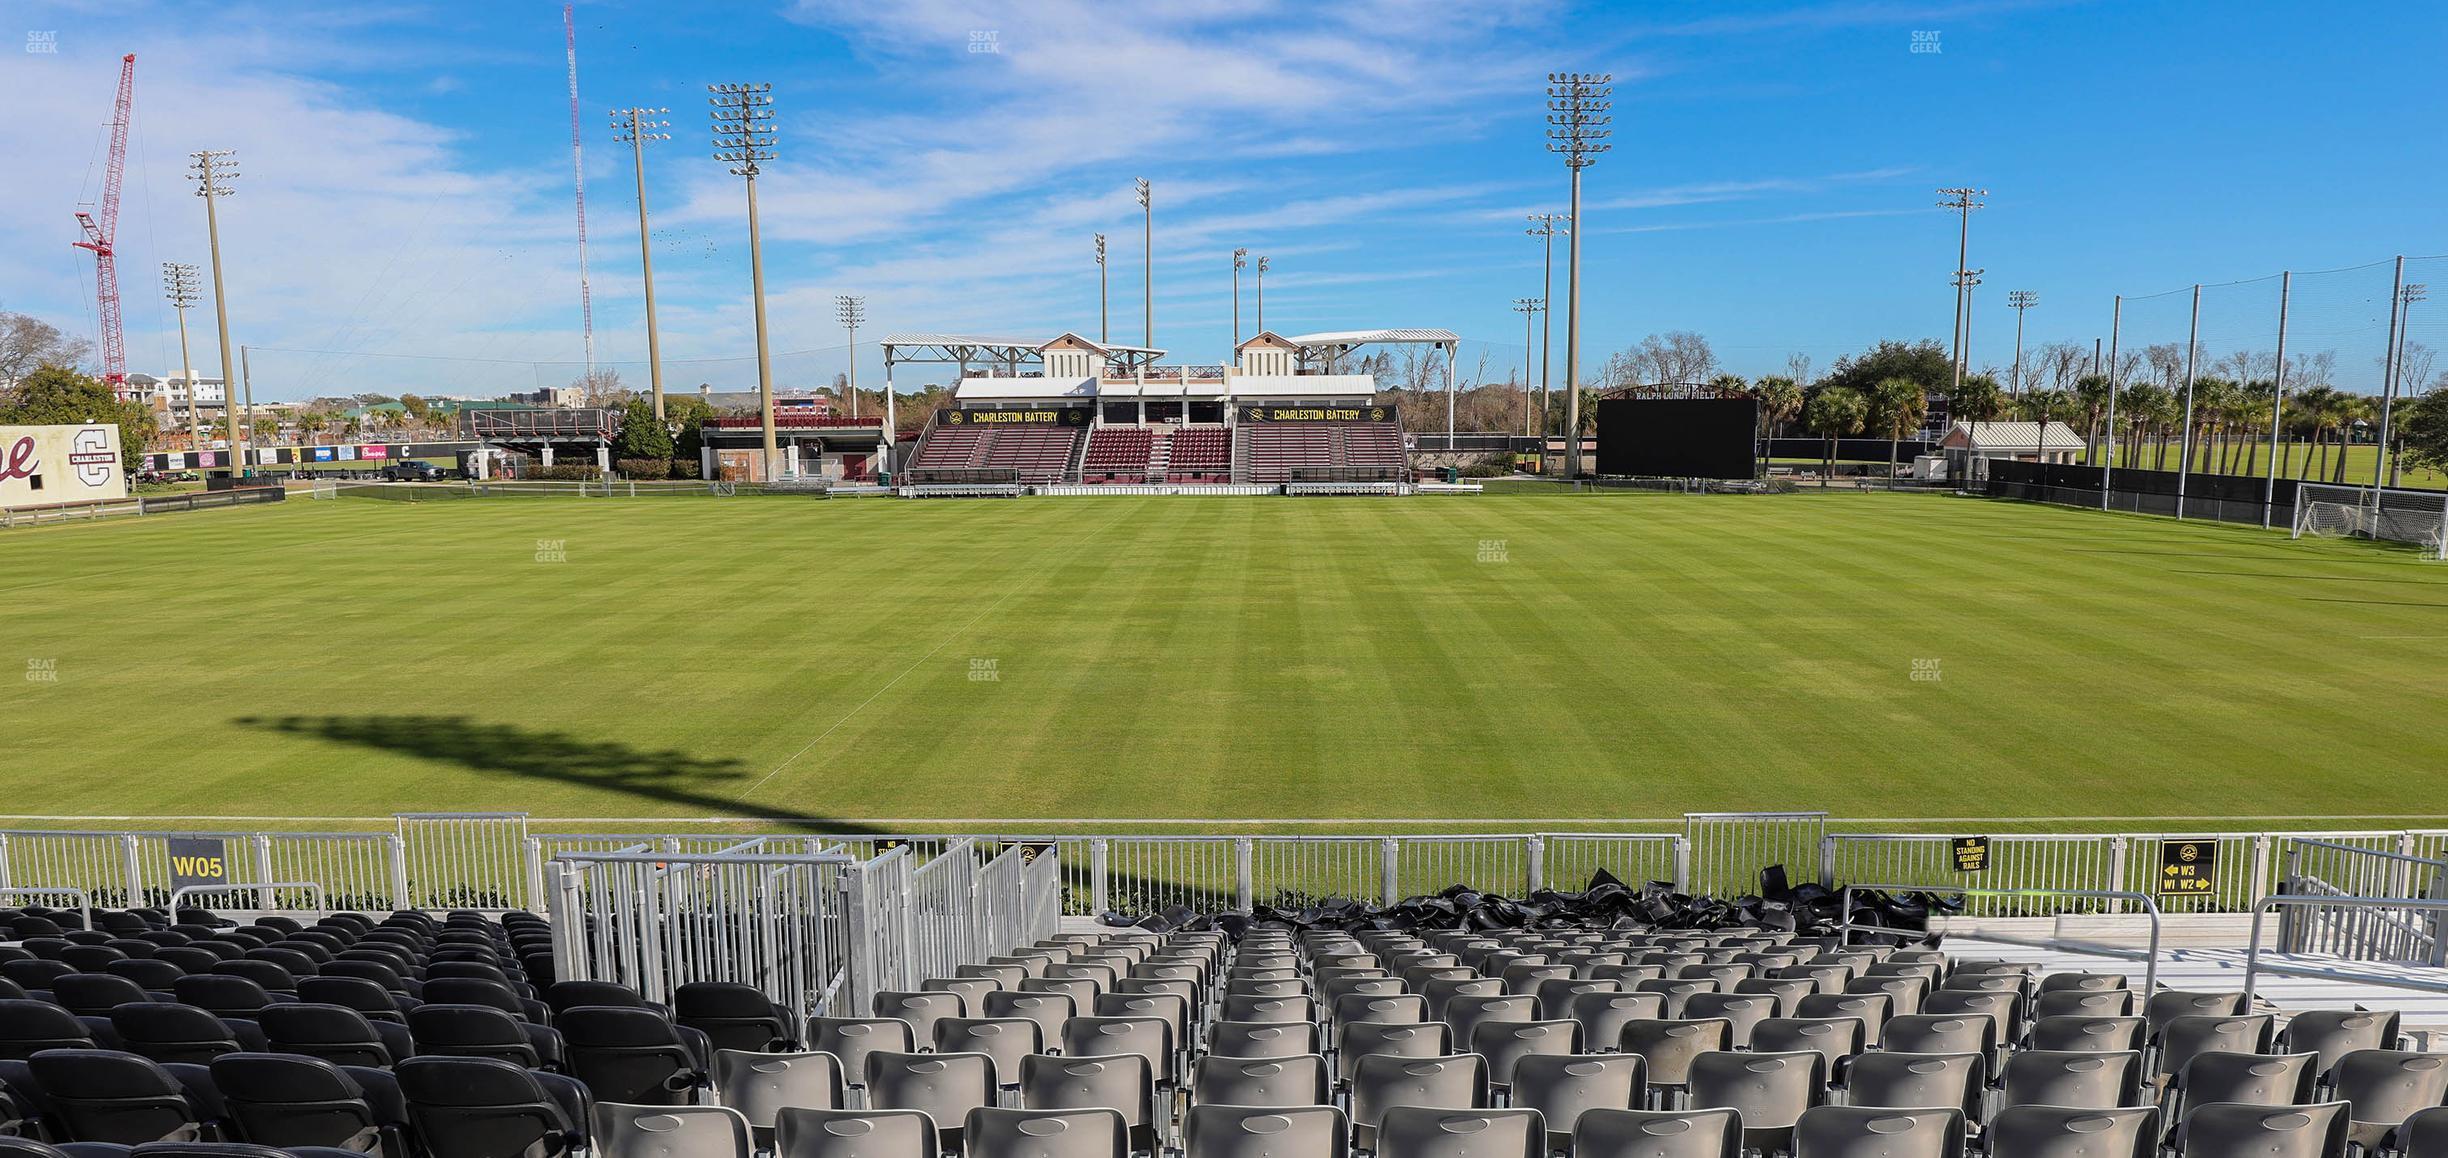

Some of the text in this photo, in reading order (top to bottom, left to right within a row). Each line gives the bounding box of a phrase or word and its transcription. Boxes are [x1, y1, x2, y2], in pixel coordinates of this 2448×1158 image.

[1636, 391, 1715, 400] RALPH LUNDY FIELD
[973, 411, 1057, 423] CHARLESTON BATTERY
[1274, 409, 1360, 420] CHARLESTON BATTERY
[1966, 839, 1976, 847] NO
[1956, 845, 1985, 855] STANDING
[1959, 853, 1983, 862] AGAINST
[172, 856, 223, 878] W05
[1962, 861, 1980, 870] RAILS
[2181, 865, 2195, 876] W3
[2180, 879, 2195, 890] W2
